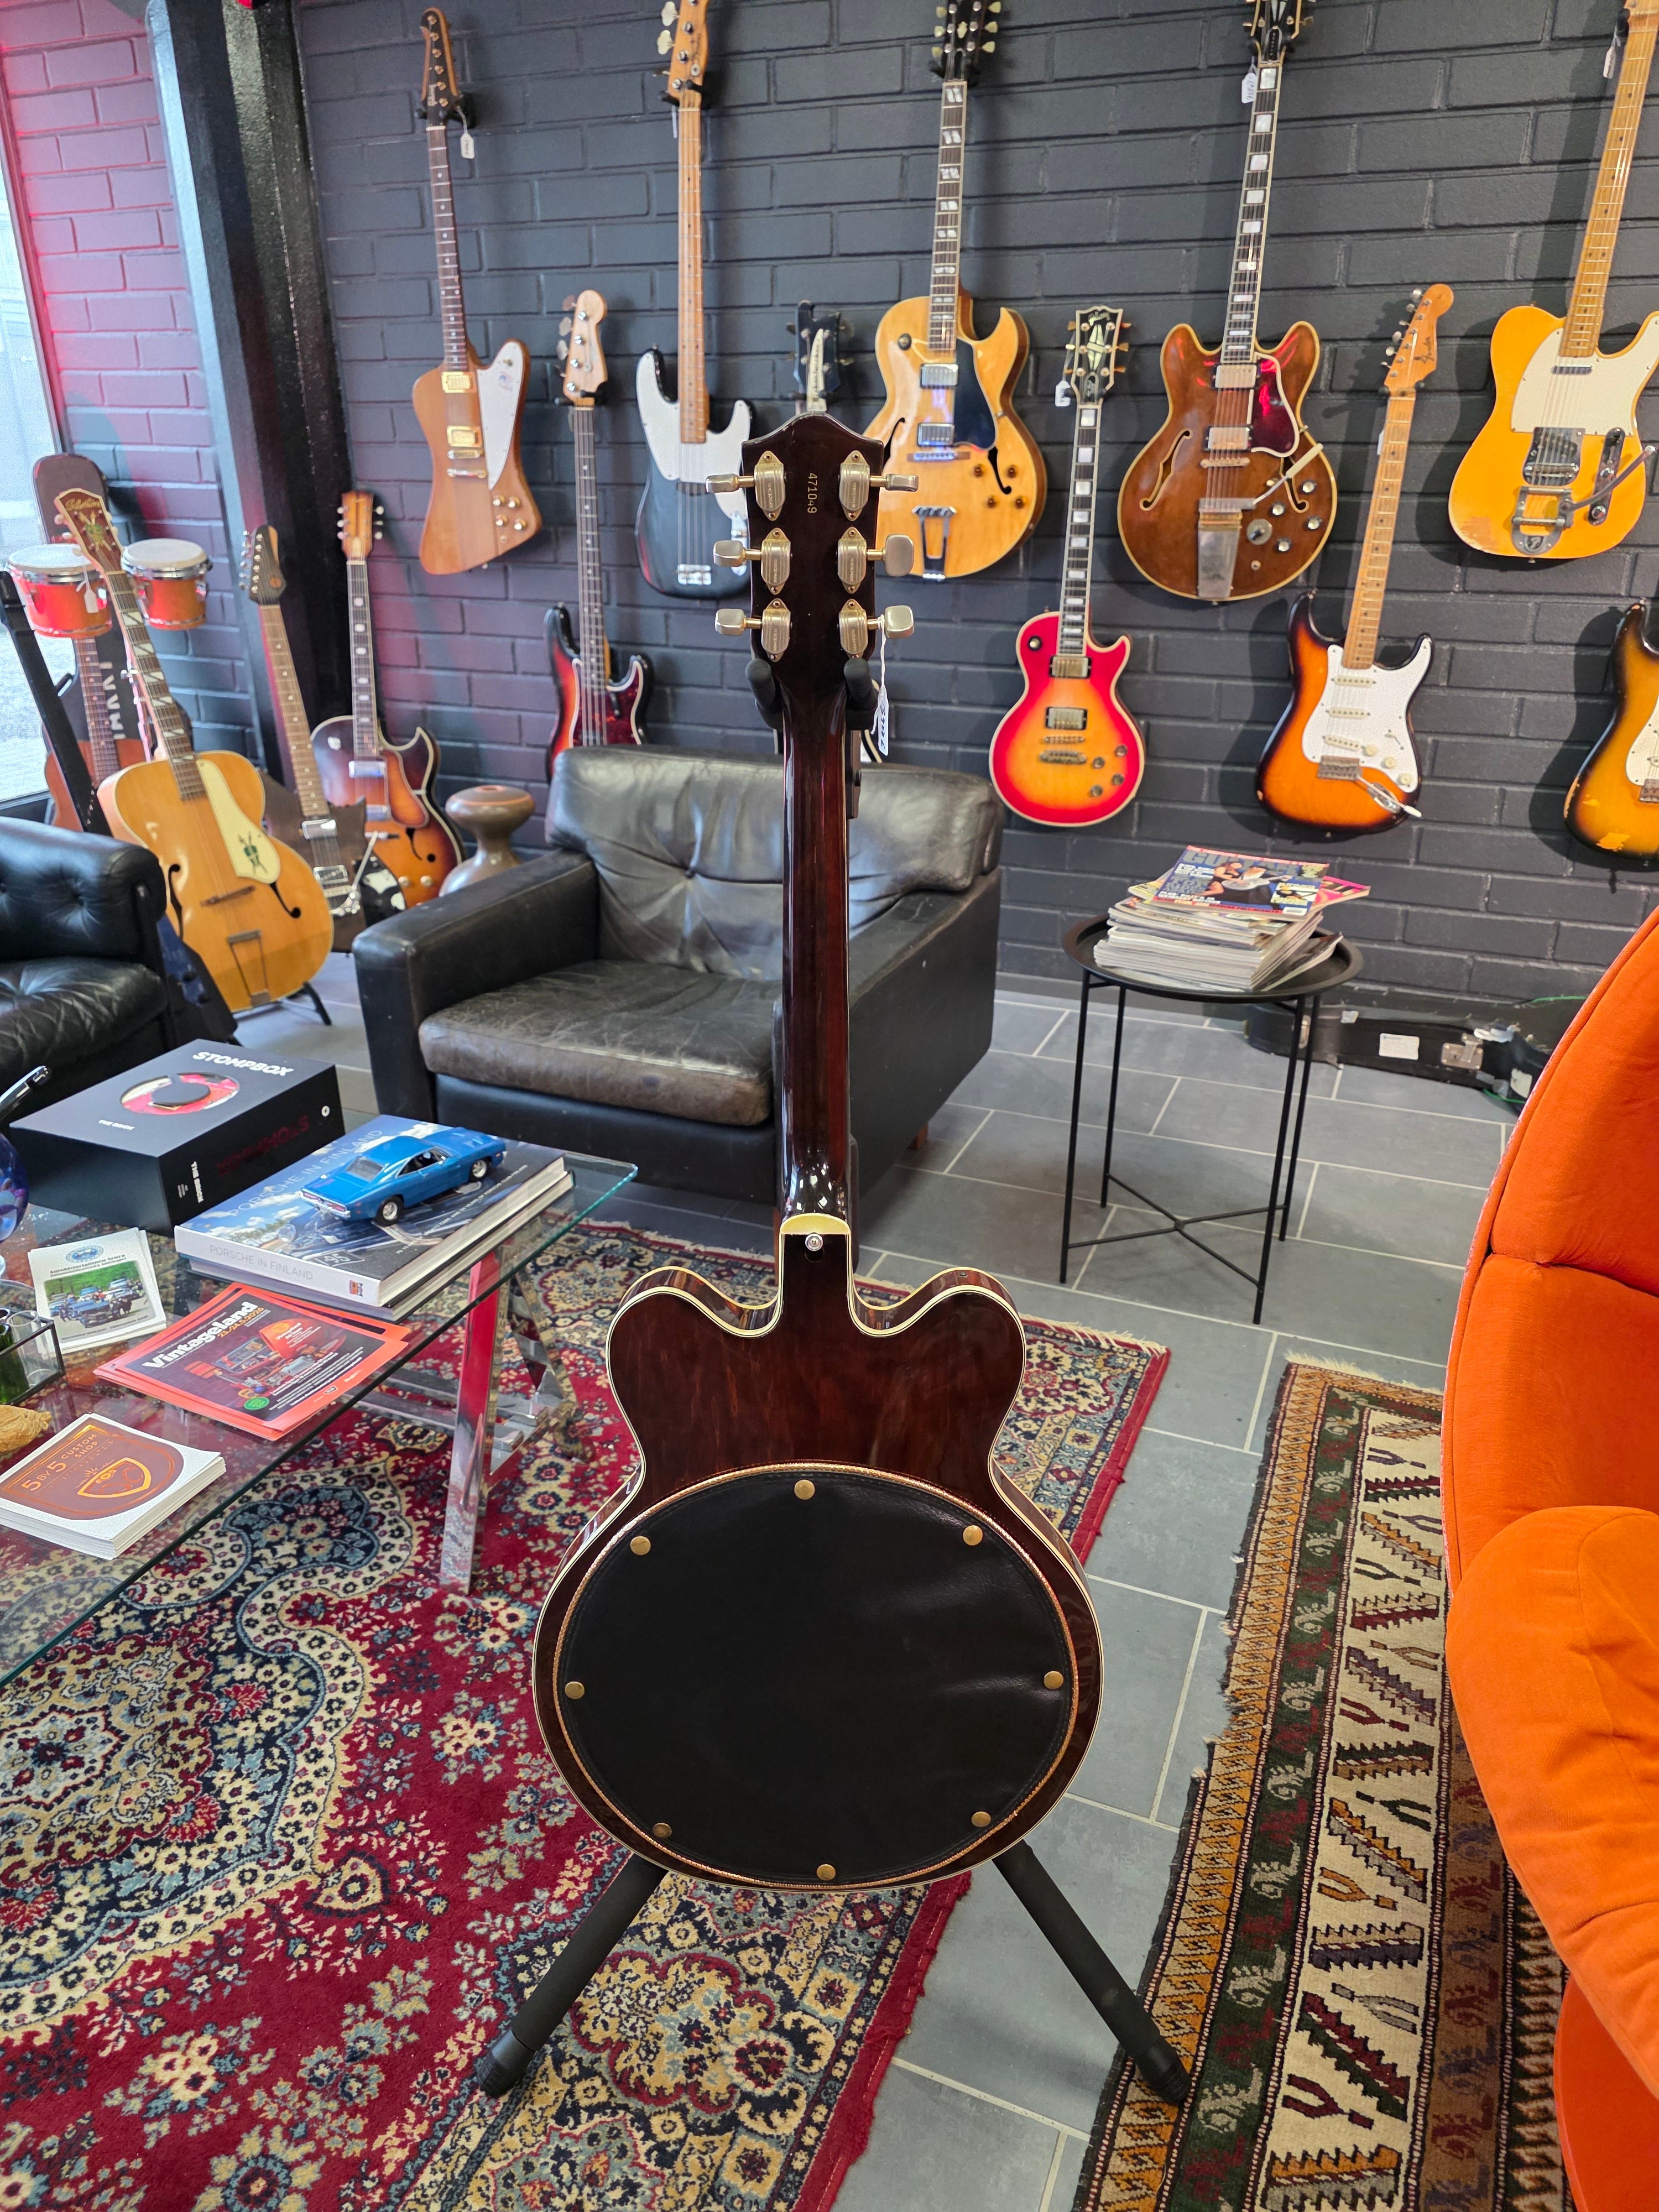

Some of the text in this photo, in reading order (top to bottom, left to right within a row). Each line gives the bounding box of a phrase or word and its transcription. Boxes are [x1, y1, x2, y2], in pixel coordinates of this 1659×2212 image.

[807, 473, 818, 513] 471049
[192, 1052, 294, 1076] STOMPBOX
[227, 1130, 383, 1217] PORSCHE IN FINLAND
[210, 1244, 313, 1280] PORSCHE IN FINLAND
[142, 1301, 258, 1368] Vintageland
[21, 1434, 97, 1491] 5 BY 5 CUSTOM
[75, 1441, 98, 1458] SHOP
